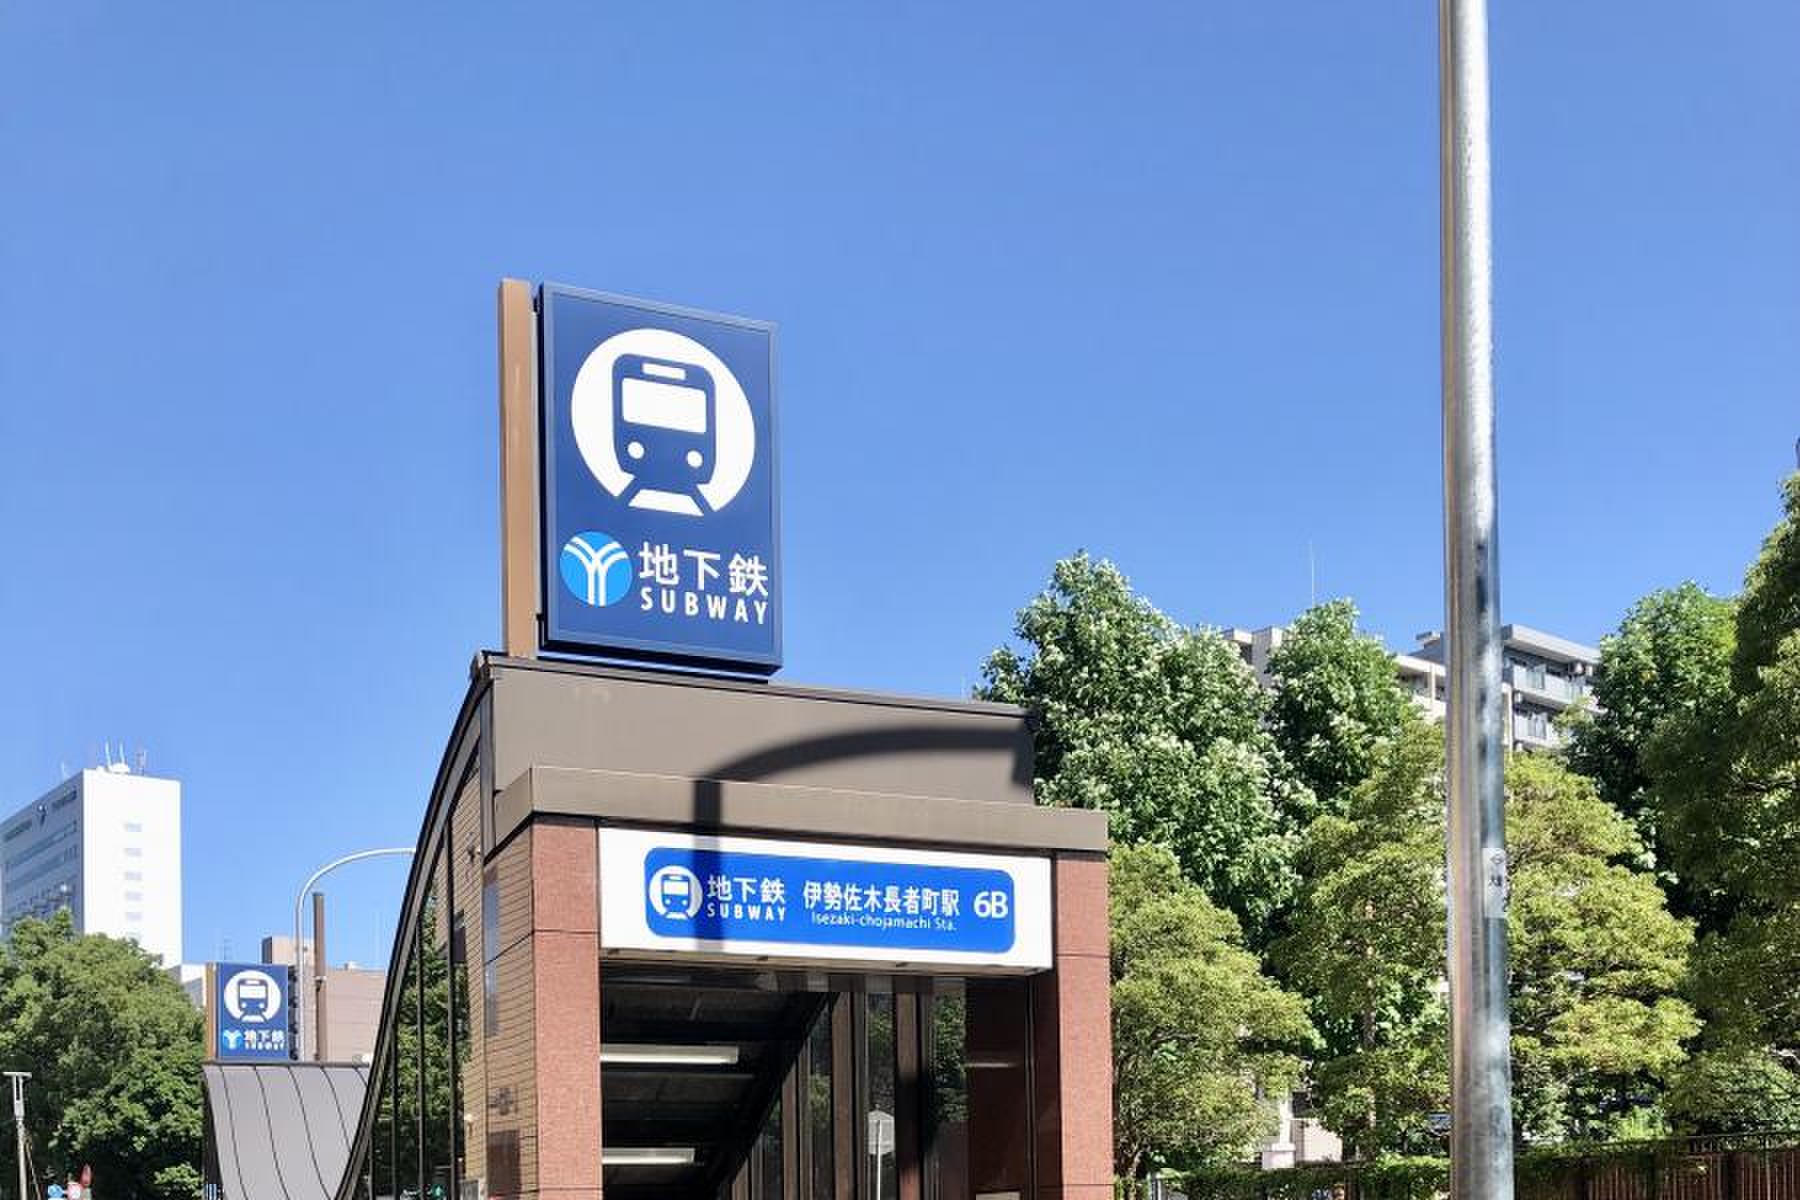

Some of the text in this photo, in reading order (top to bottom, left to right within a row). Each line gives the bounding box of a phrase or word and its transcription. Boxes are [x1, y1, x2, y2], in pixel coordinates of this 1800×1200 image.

[639, 541, 768, 596] 地下鉄
[640, 587, 767, 624] SUBWAY
[707, 876, 786, 905] 地下鉄
[803, 880, 1008, 919] 伊勢佐木長者町駅 6B
[707, 903, 786, 922] SUBWAY
[811, 912, 957, 931] Isezaki-chojamachi Sta.
